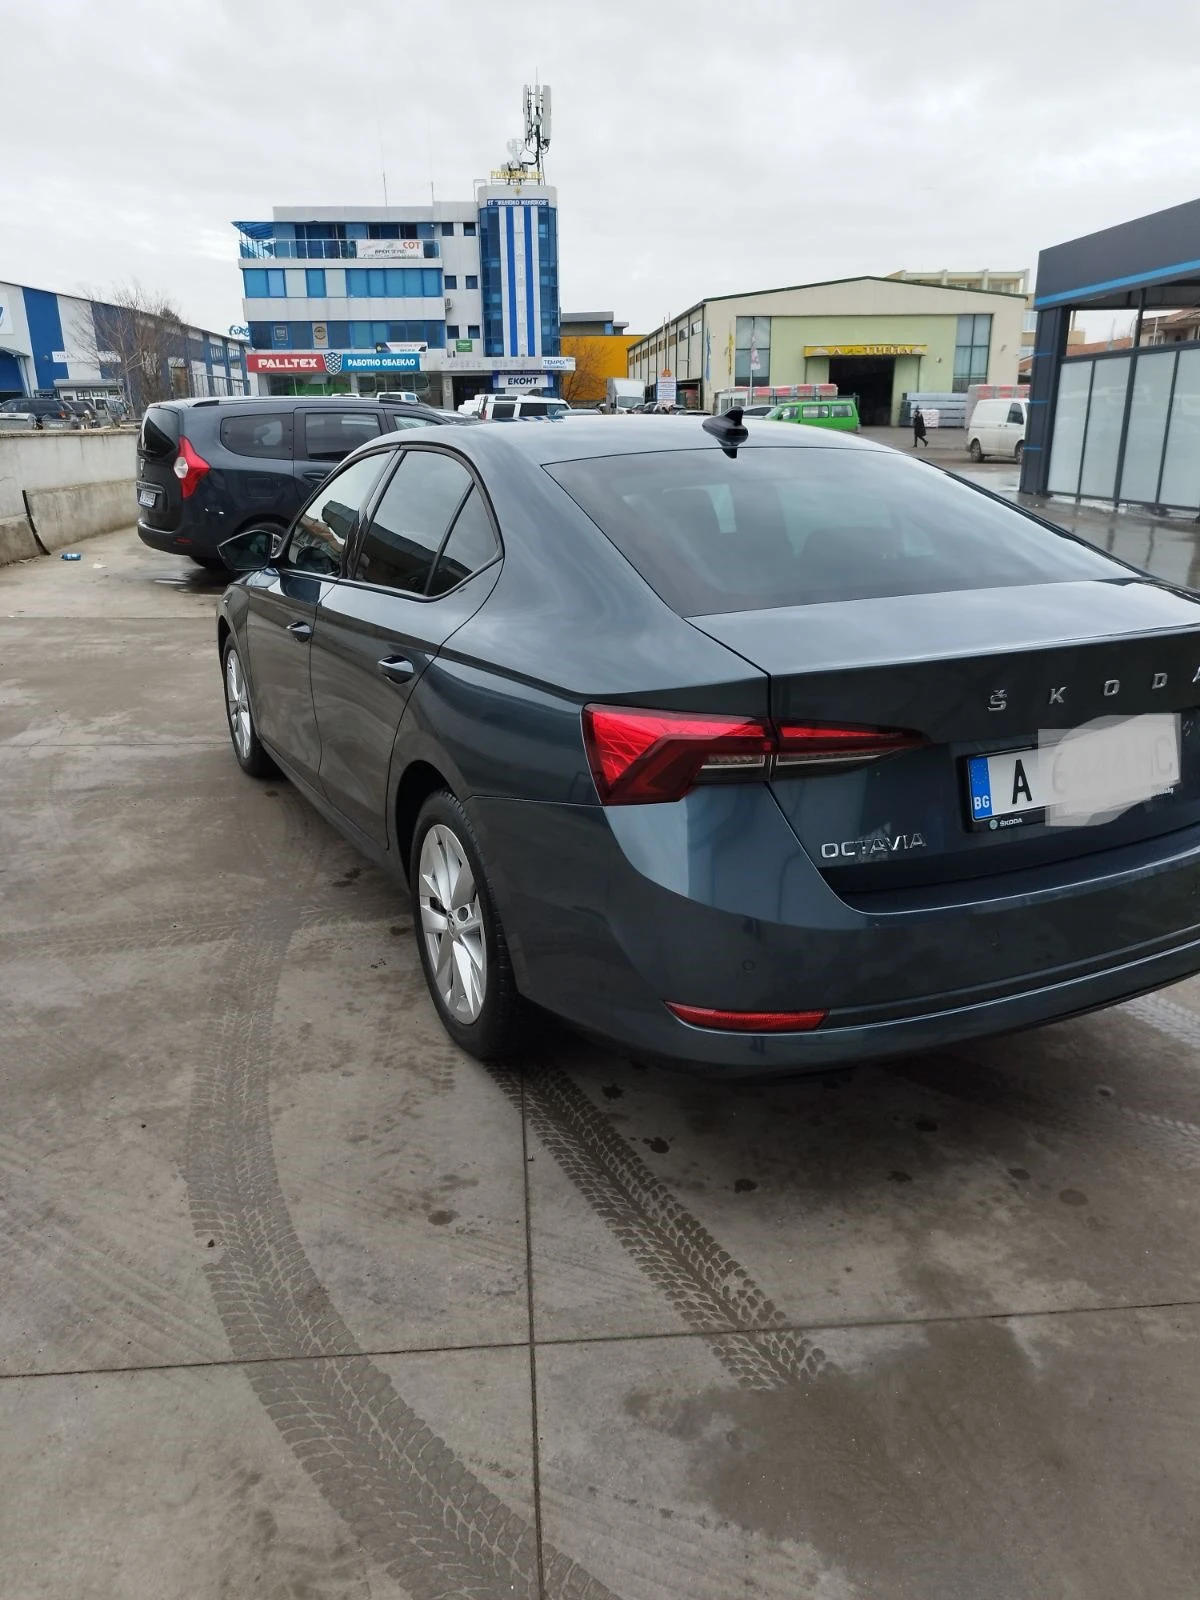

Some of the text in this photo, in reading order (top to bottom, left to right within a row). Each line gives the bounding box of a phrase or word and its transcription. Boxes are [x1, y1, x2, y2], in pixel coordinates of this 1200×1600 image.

[257, 358, 318, 369] PALLTEX
[347, 358, 416, 367] РАБОТНО ОБЛЕКЛО
[507, 377, 539, 385] ЕКОНТ
[973, 795, 991, 811] BG
[999, 817, 1024, 827] ŠKODA
[820, 832, 927, 859] OCTAVIA
